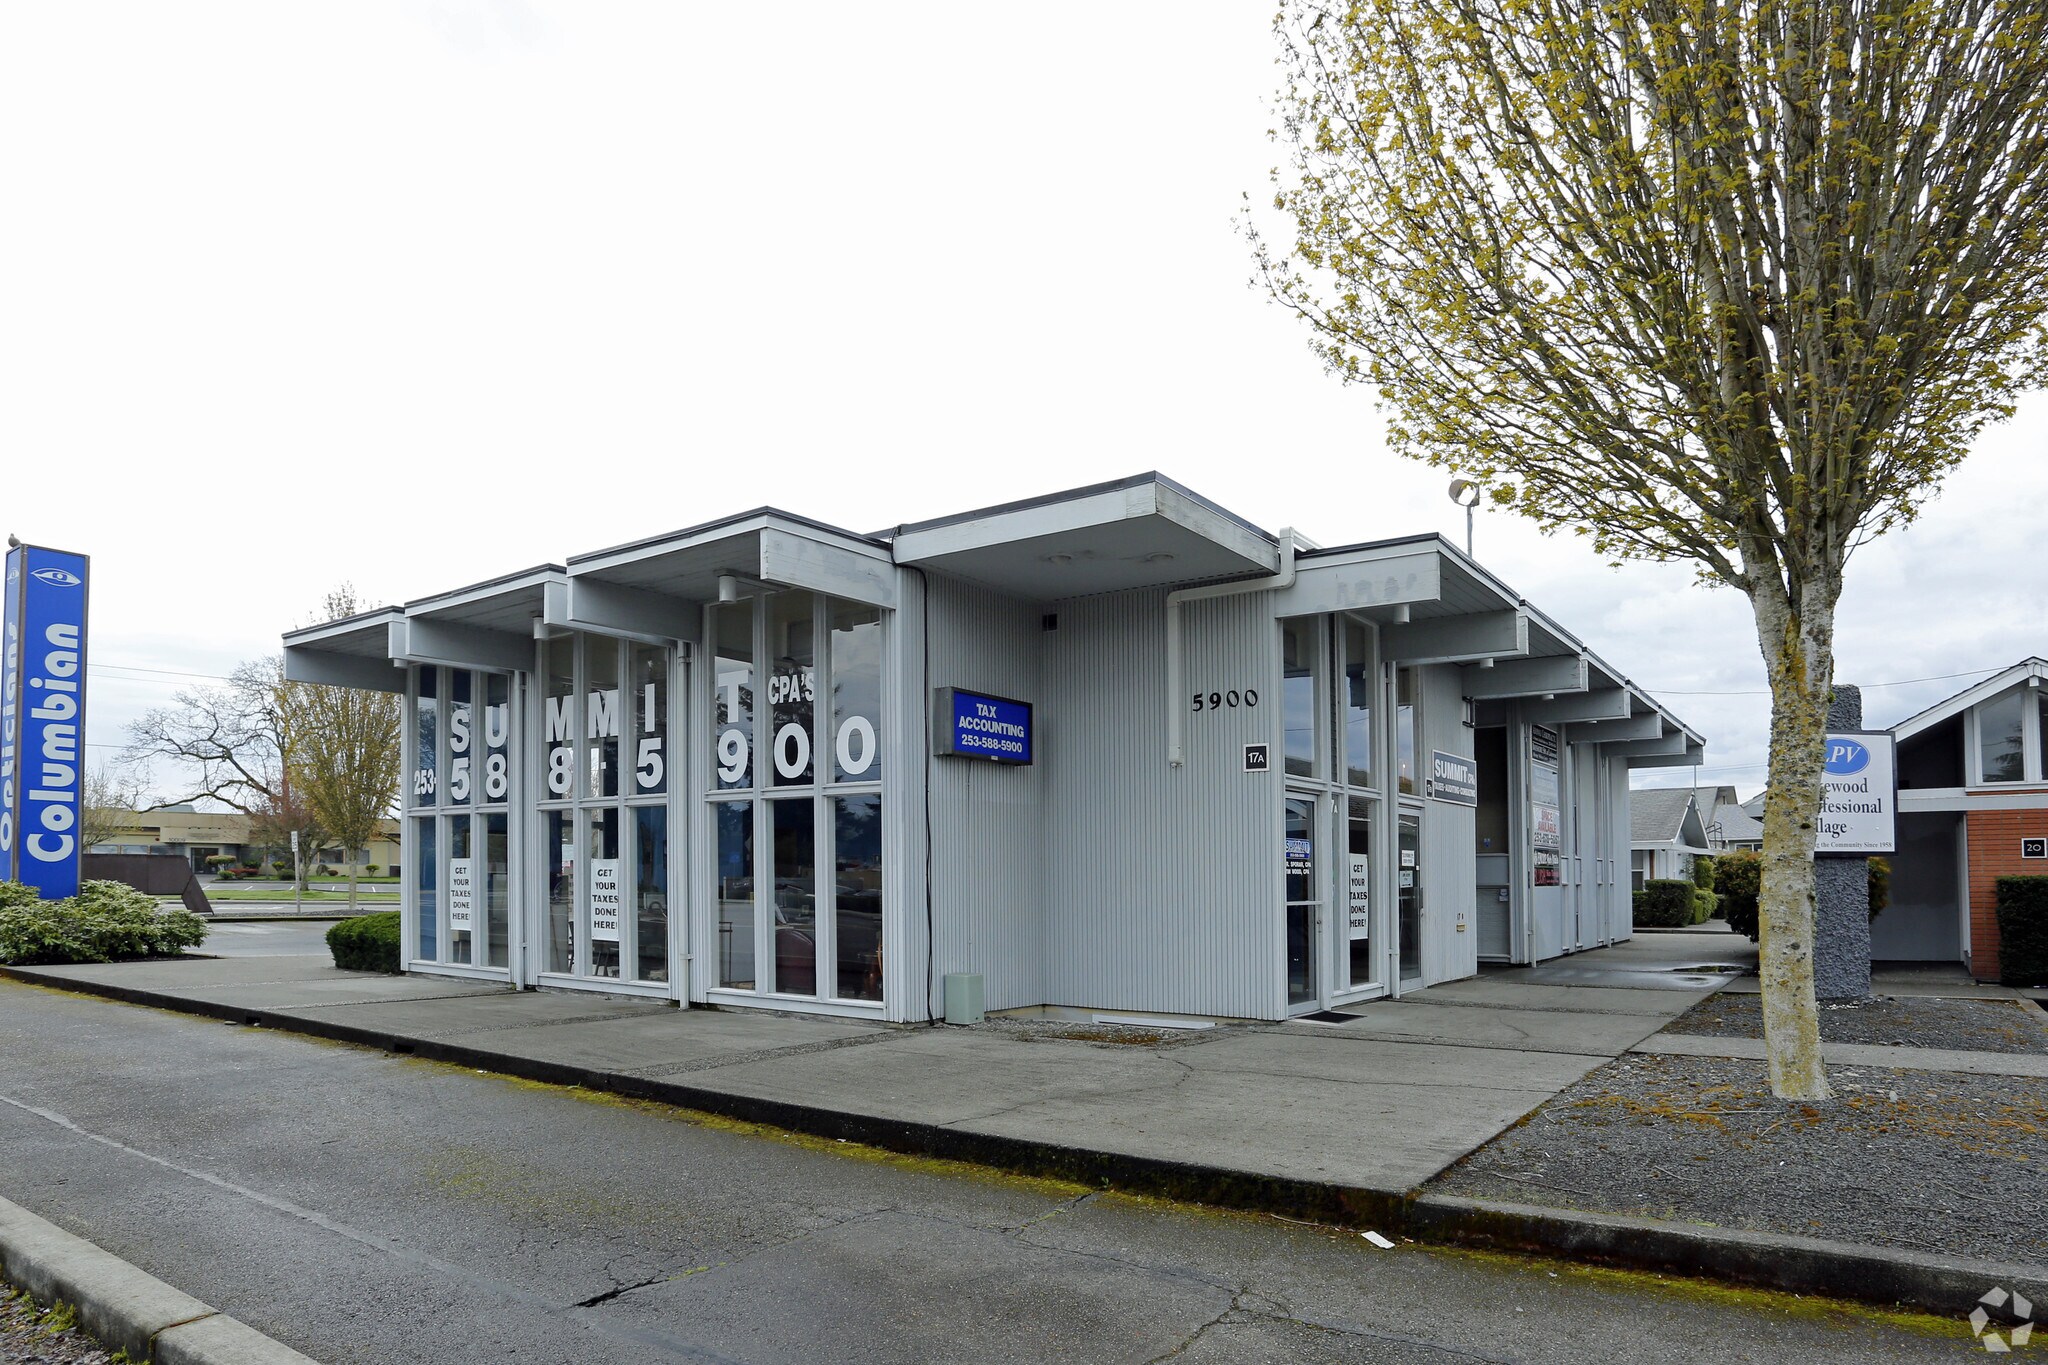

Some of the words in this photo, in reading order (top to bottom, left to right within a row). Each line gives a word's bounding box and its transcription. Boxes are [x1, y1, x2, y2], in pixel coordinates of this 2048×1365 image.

[767, 672, 815, 705] CPA'S
[1192, 689, 1258, 712] 5900
[976, 703, 997, 719] TAX
[958, 715, 1025, 738] ACCOUNTING
[26, 623, 79, 863] Columbian
[961, 734, 1023, 753] 253-588-5900
[1247, 752, 1265, 763] 17A
[1826, 746, 1862, 764] PV
[1434, 758, 1468, 783] SUMMIT
[1821, 778, 1868, 793] ewood
[1818, 797, 1882, 814] fessional
[1816, 818, 1847, 838] llage
[595, 882, 616, 890] YOUR
[1351, 878, 1365, 886] YOUR
[592, 895, 619, 903] TAXES
[1350, 892, 1367, 900] TAXES
[595, 908, 617, 916] DONE
[594, 921, 617, 929] HERE!
[1350, 919, 1366, 927] HERE!
